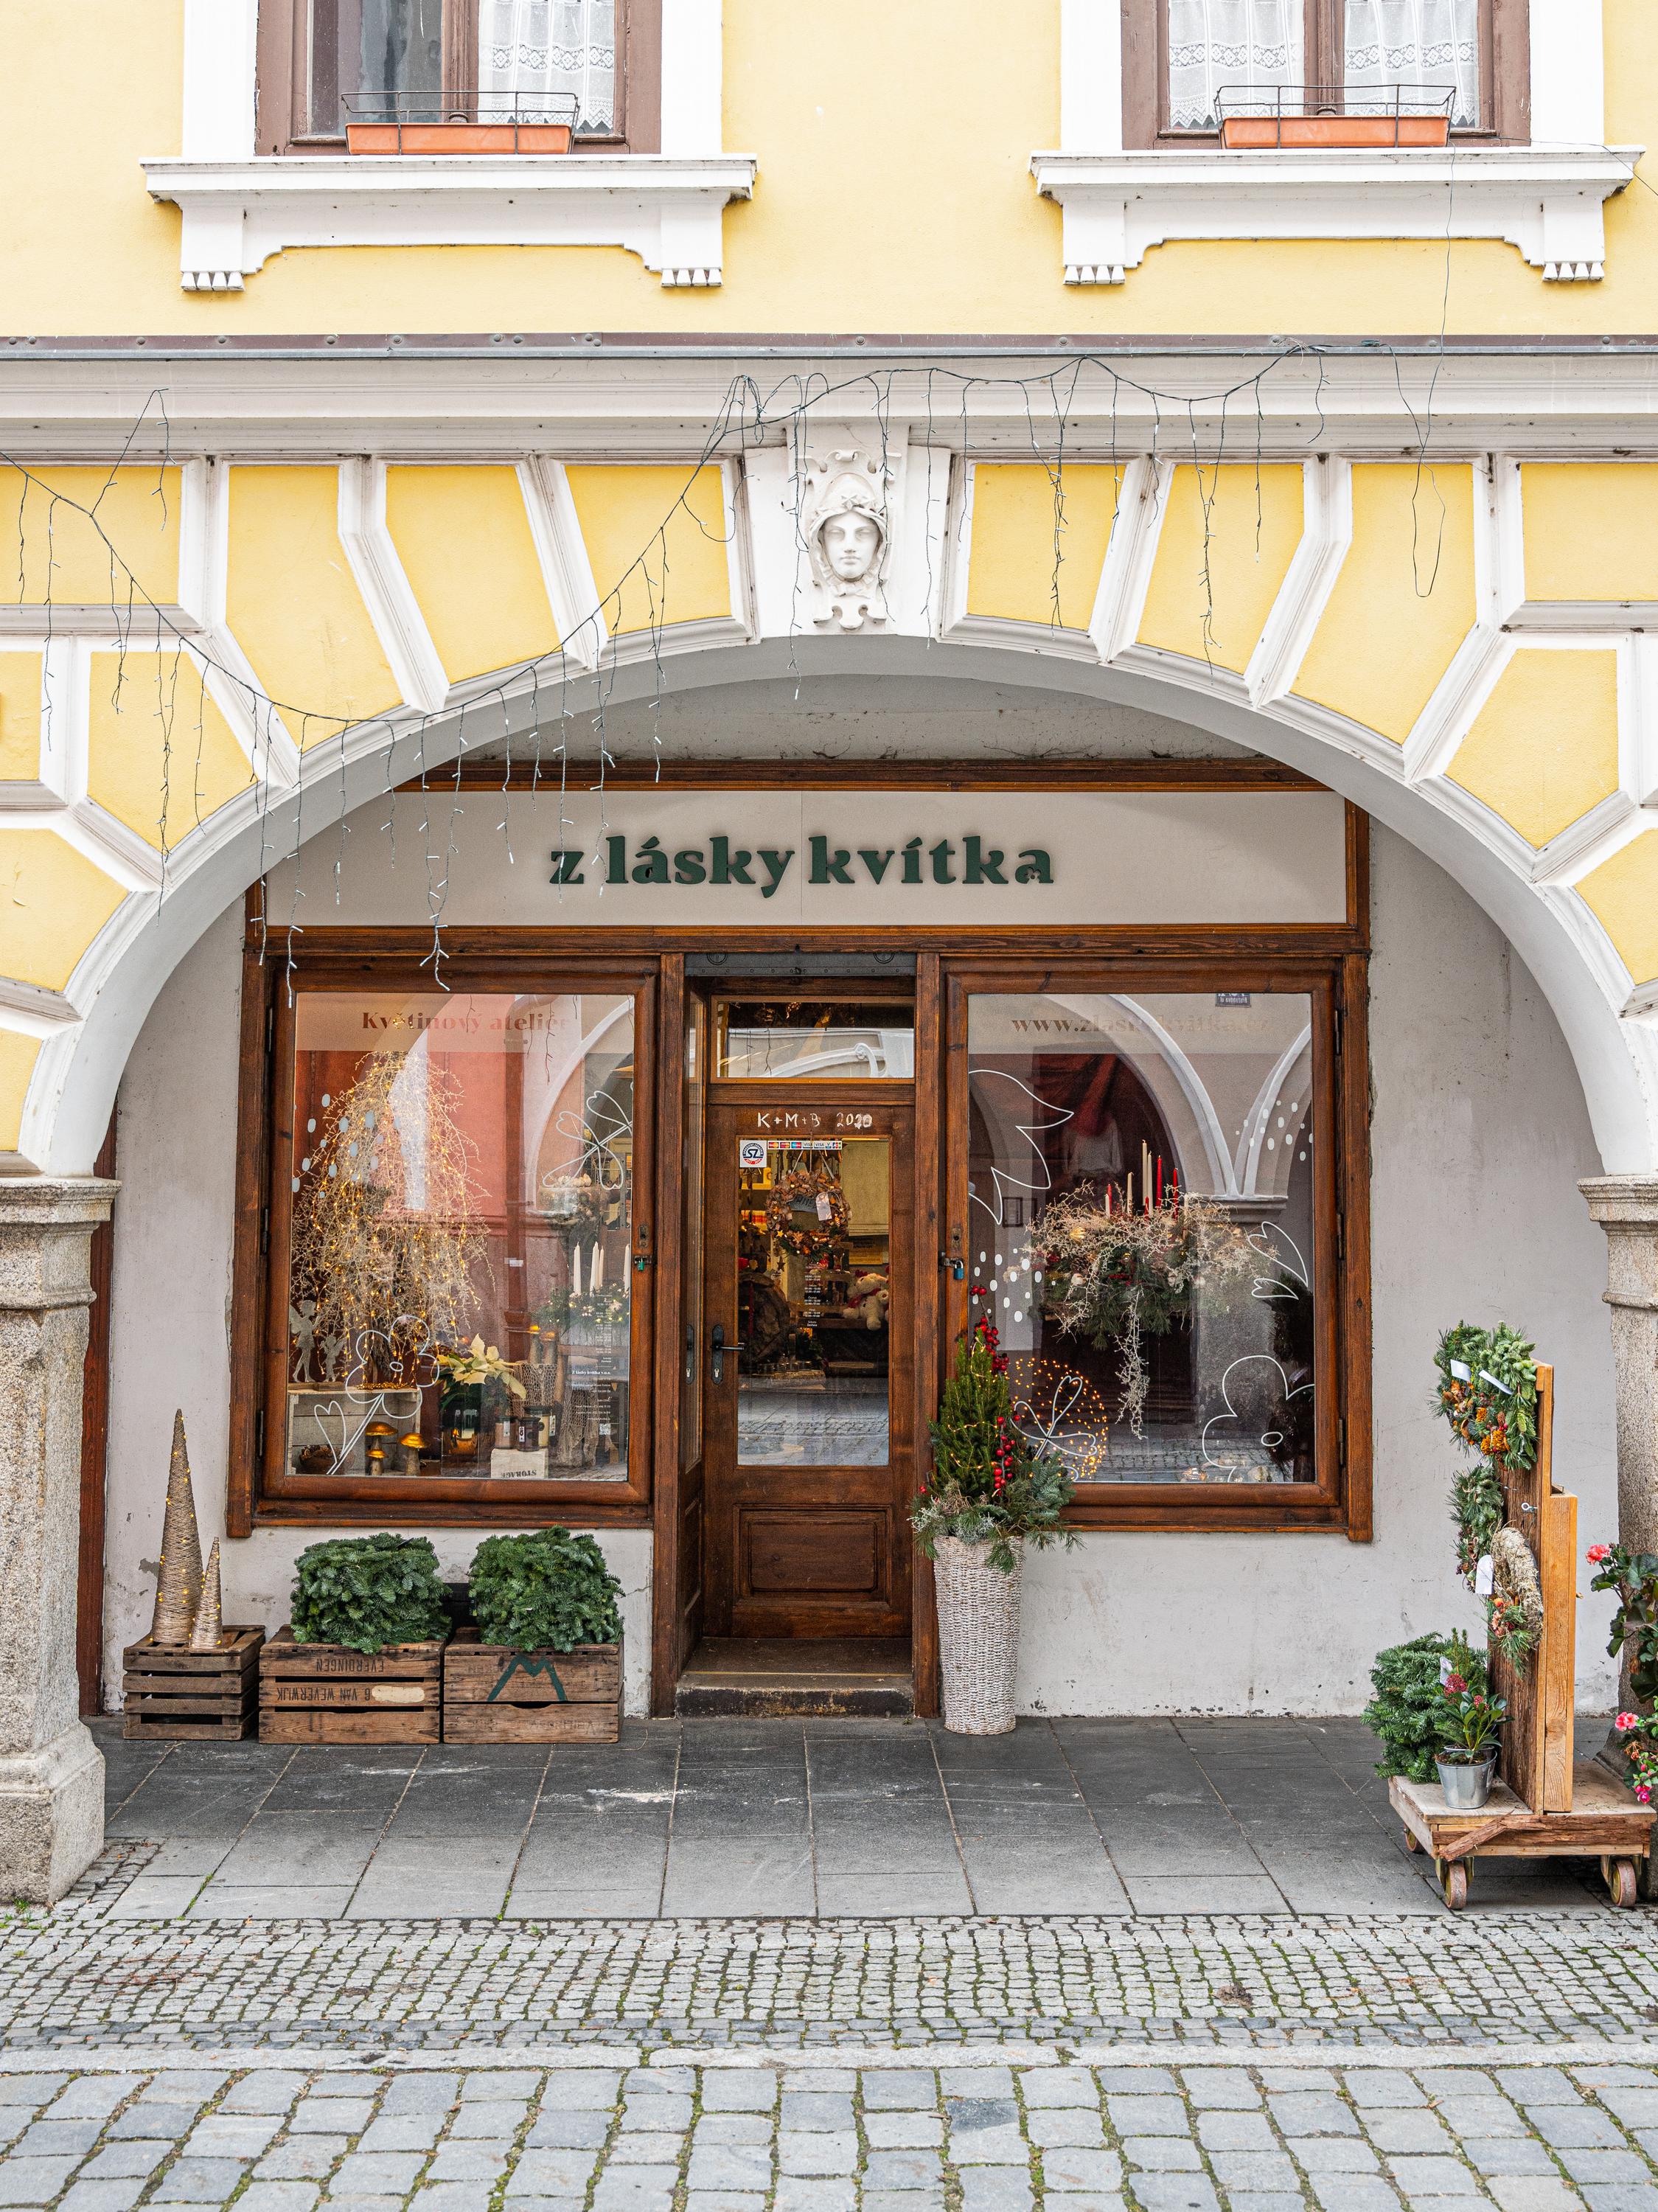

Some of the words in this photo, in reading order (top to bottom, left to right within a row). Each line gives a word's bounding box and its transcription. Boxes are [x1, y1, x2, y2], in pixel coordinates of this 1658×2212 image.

[549, 850, 585, 886] z
[605, 835, 795, 899] lásky
[808, 835, 1055, 885] kvítka
[316, 1658, 384, 1672] EVERDINGEN
[276, 1687, 334, 1701] WEVERWIJK
[340, 1687, 358, 1701] VAN
